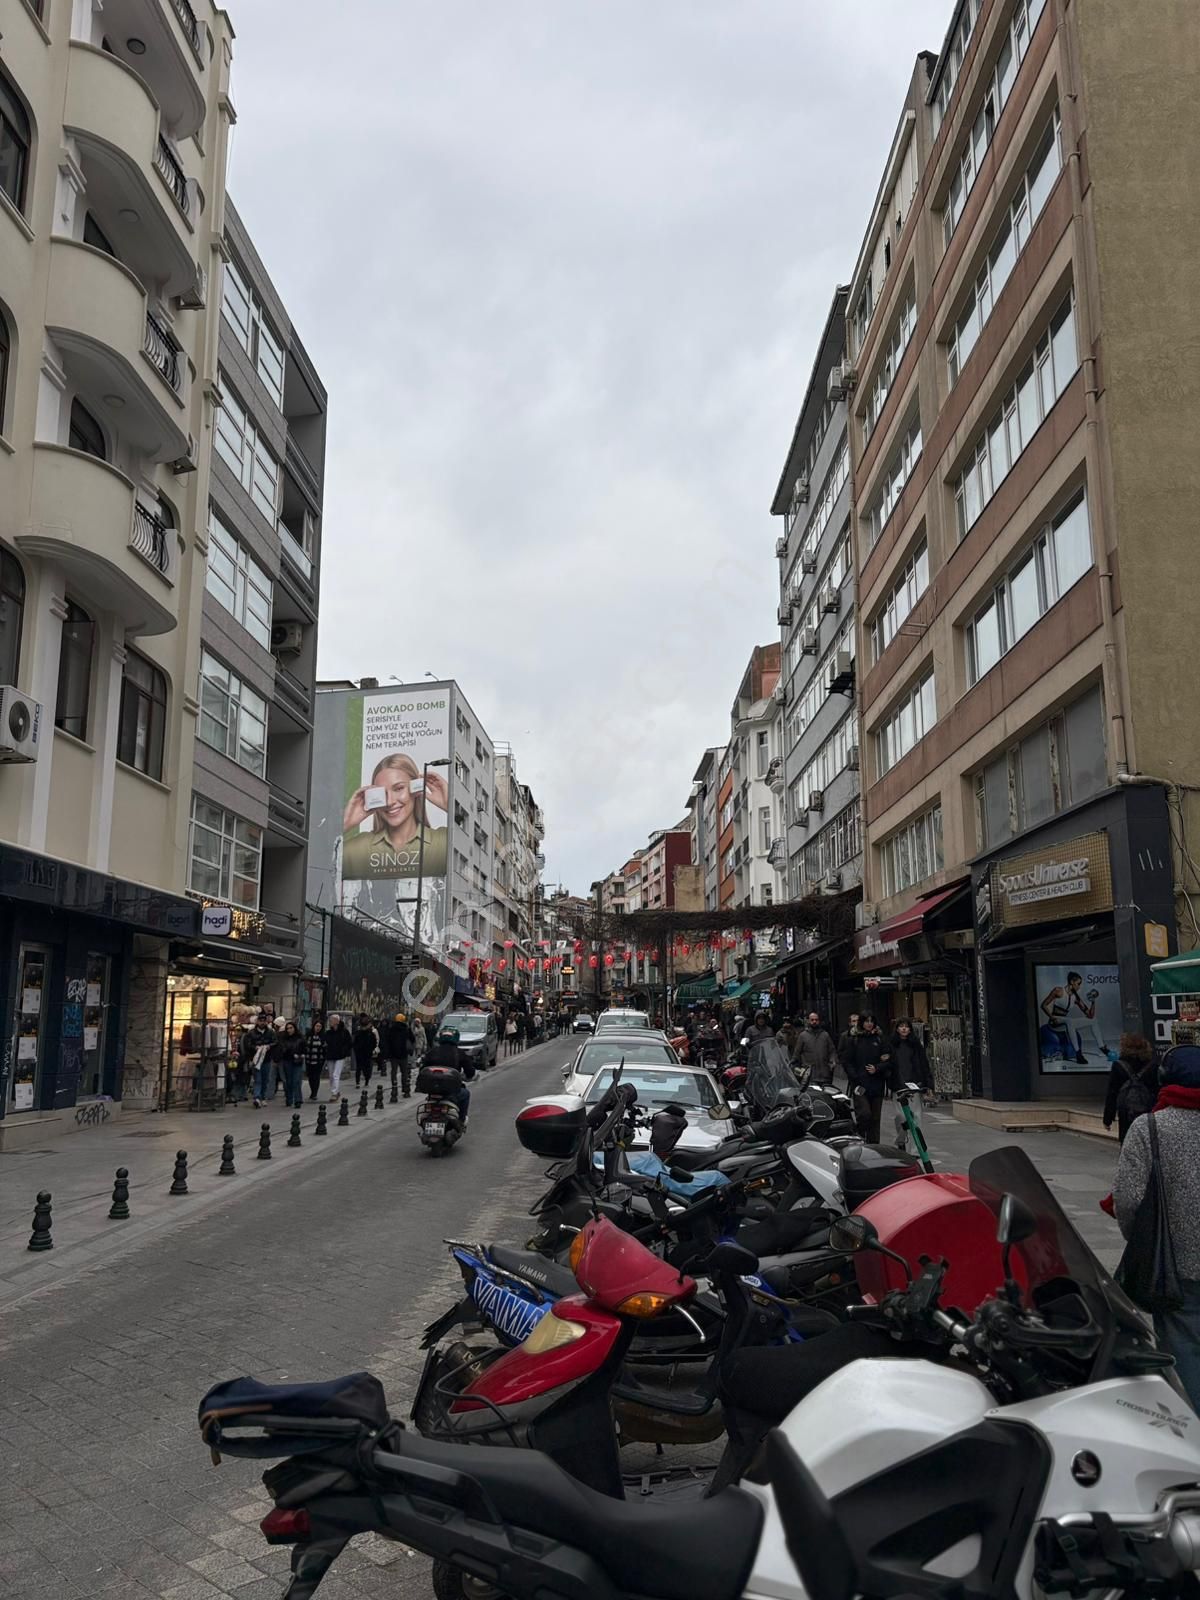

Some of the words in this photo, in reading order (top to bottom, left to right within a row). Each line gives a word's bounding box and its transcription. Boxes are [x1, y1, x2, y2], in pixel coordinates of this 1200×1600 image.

[367, 704, 414, 715] AVOKADO
[417, 701, 446, 711] BOMB
[400, 722, 410, 730] VE
[415, 728, 443, 738] YOĞUN
[365, 741, 383, 751] NEM
[1051, 884, 1069, 896] HEALTH
[1070, 880, 1084, 892] CLUB
[204, 914, 228, 925] hadi
[518, 1263, 548, 1283] YAMAHA
[1115, 1398, 1189, 1429] CROSSTOURER
